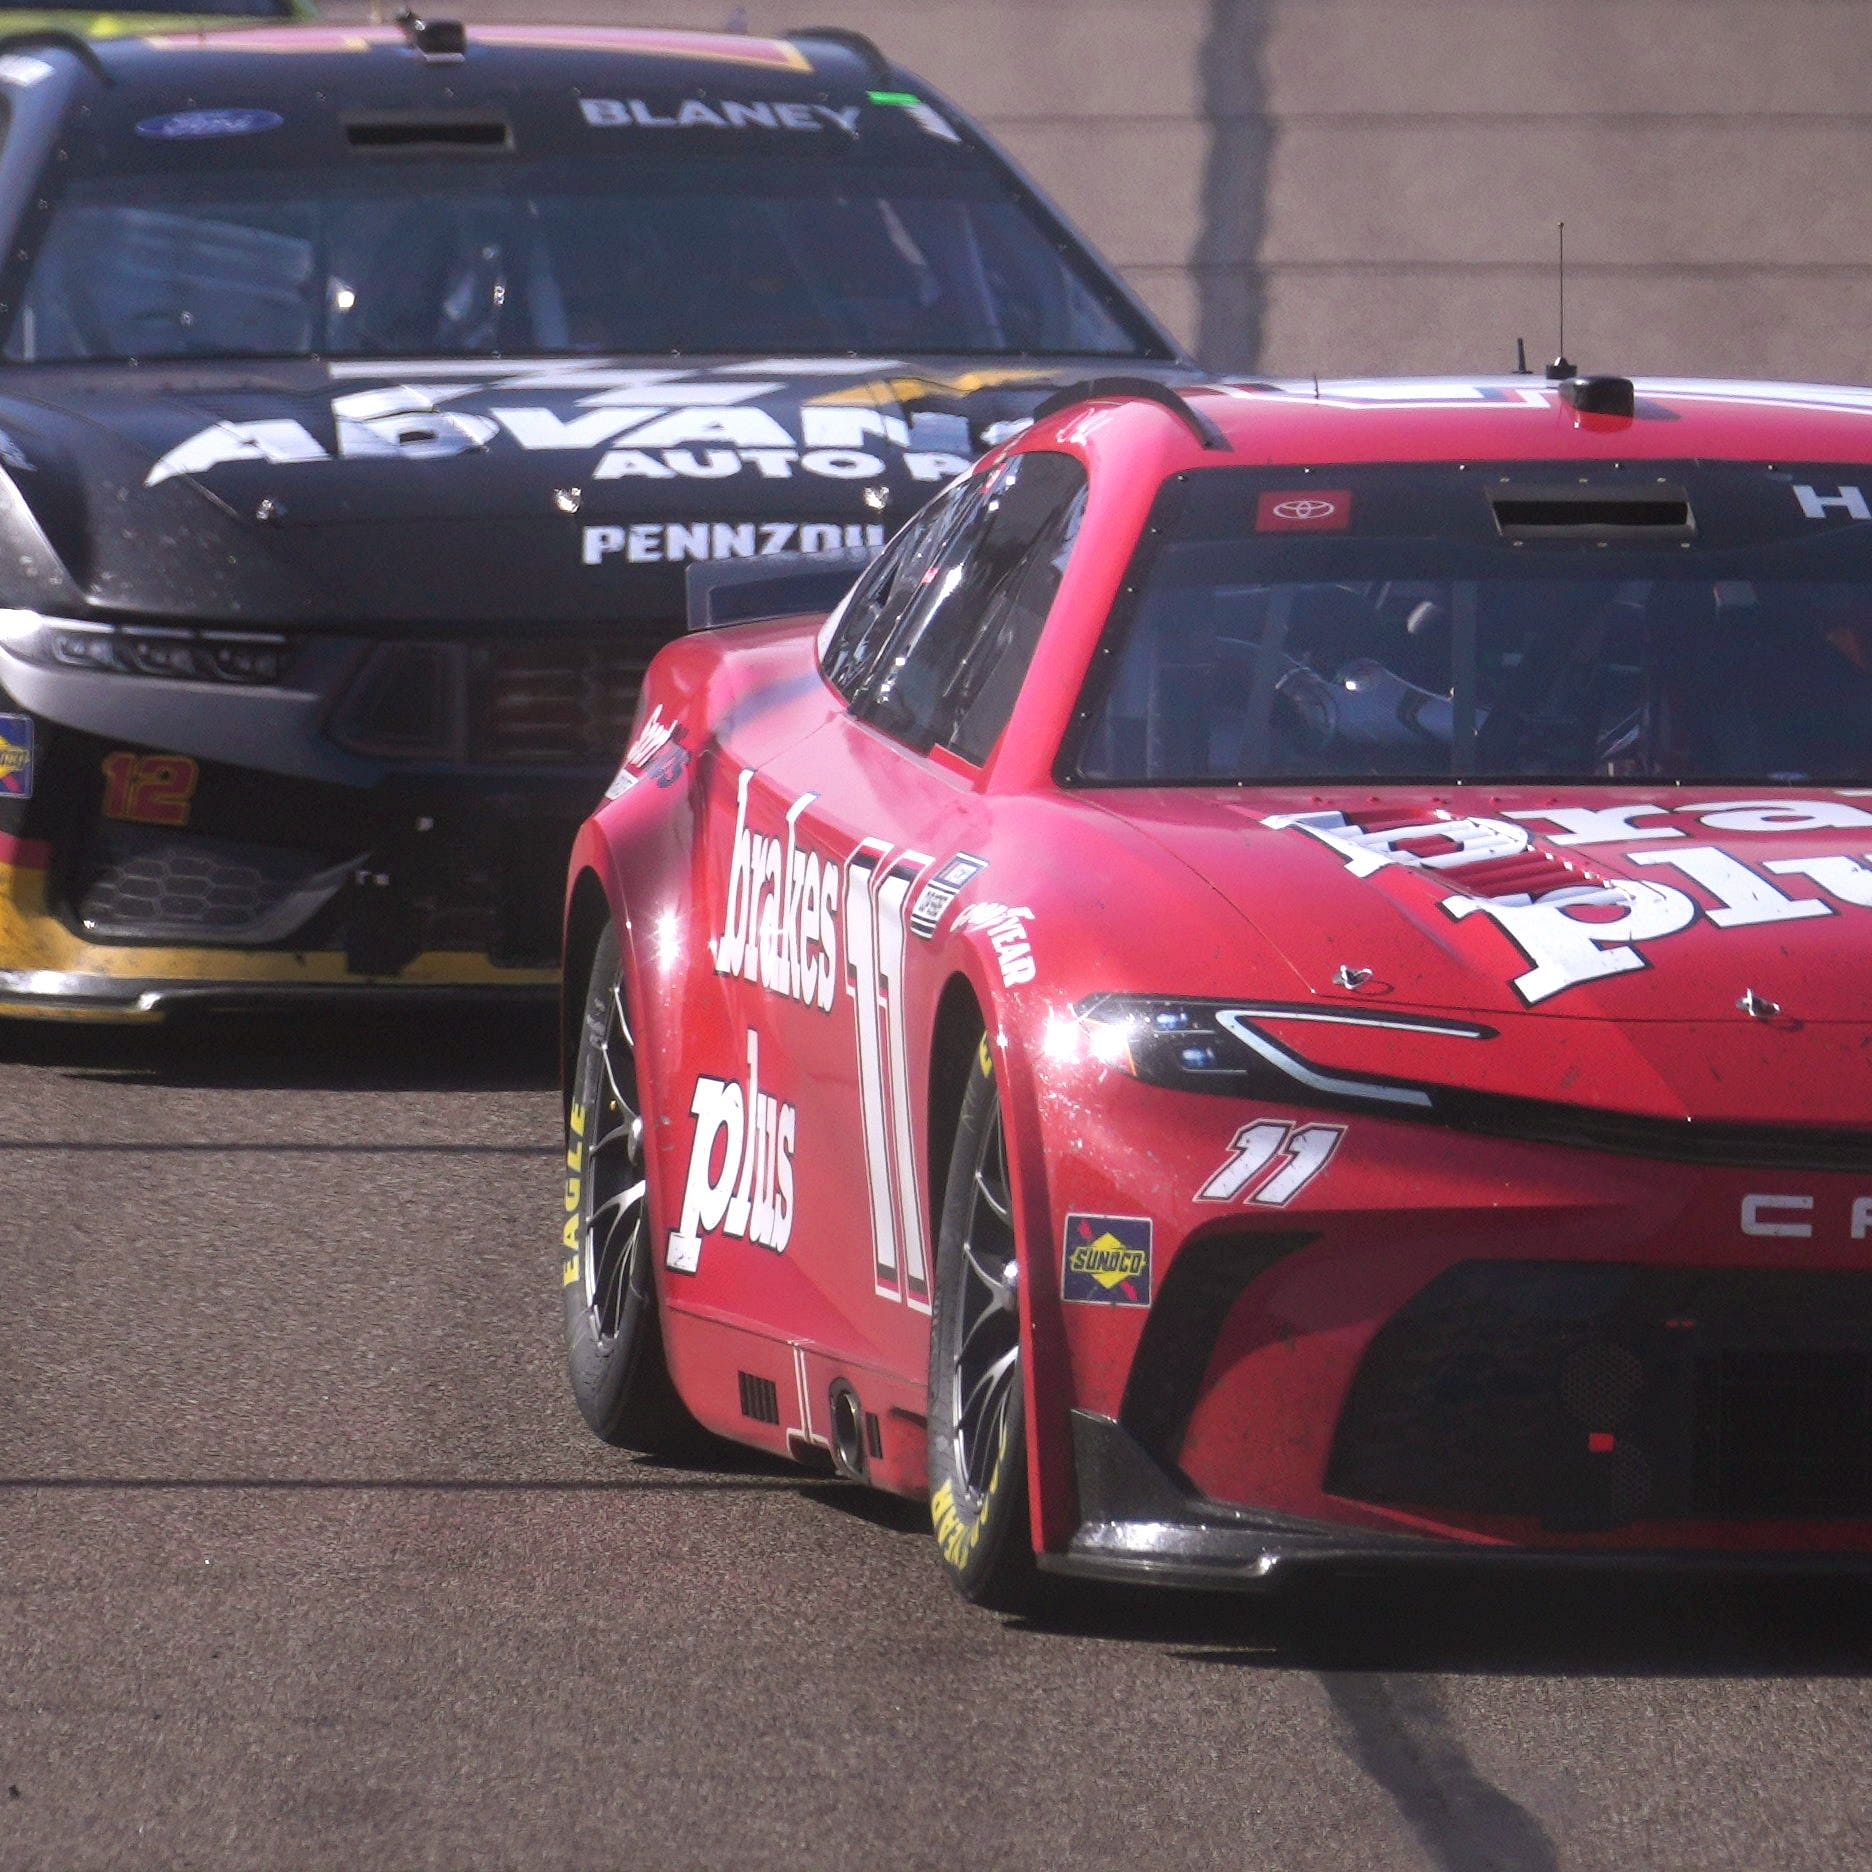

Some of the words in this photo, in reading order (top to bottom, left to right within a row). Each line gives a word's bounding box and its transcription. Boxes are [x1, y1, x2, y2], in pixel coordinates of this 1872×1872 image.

[580, 96, 861, 136] BLANEY
[593, 448, 886, 481] AUTO
[101, 751, 200, 828] 12
[714, 767, 839, 1015] brakes
[843, 835, 936, 1316] 11
[562, 1101, 587, 1287] EAGLE
[666, 1027, 798, 1274] plus
[1194, 1119, 1349, 1208] 11
[1071, 1242, 1146, 1279] SUNOCO
